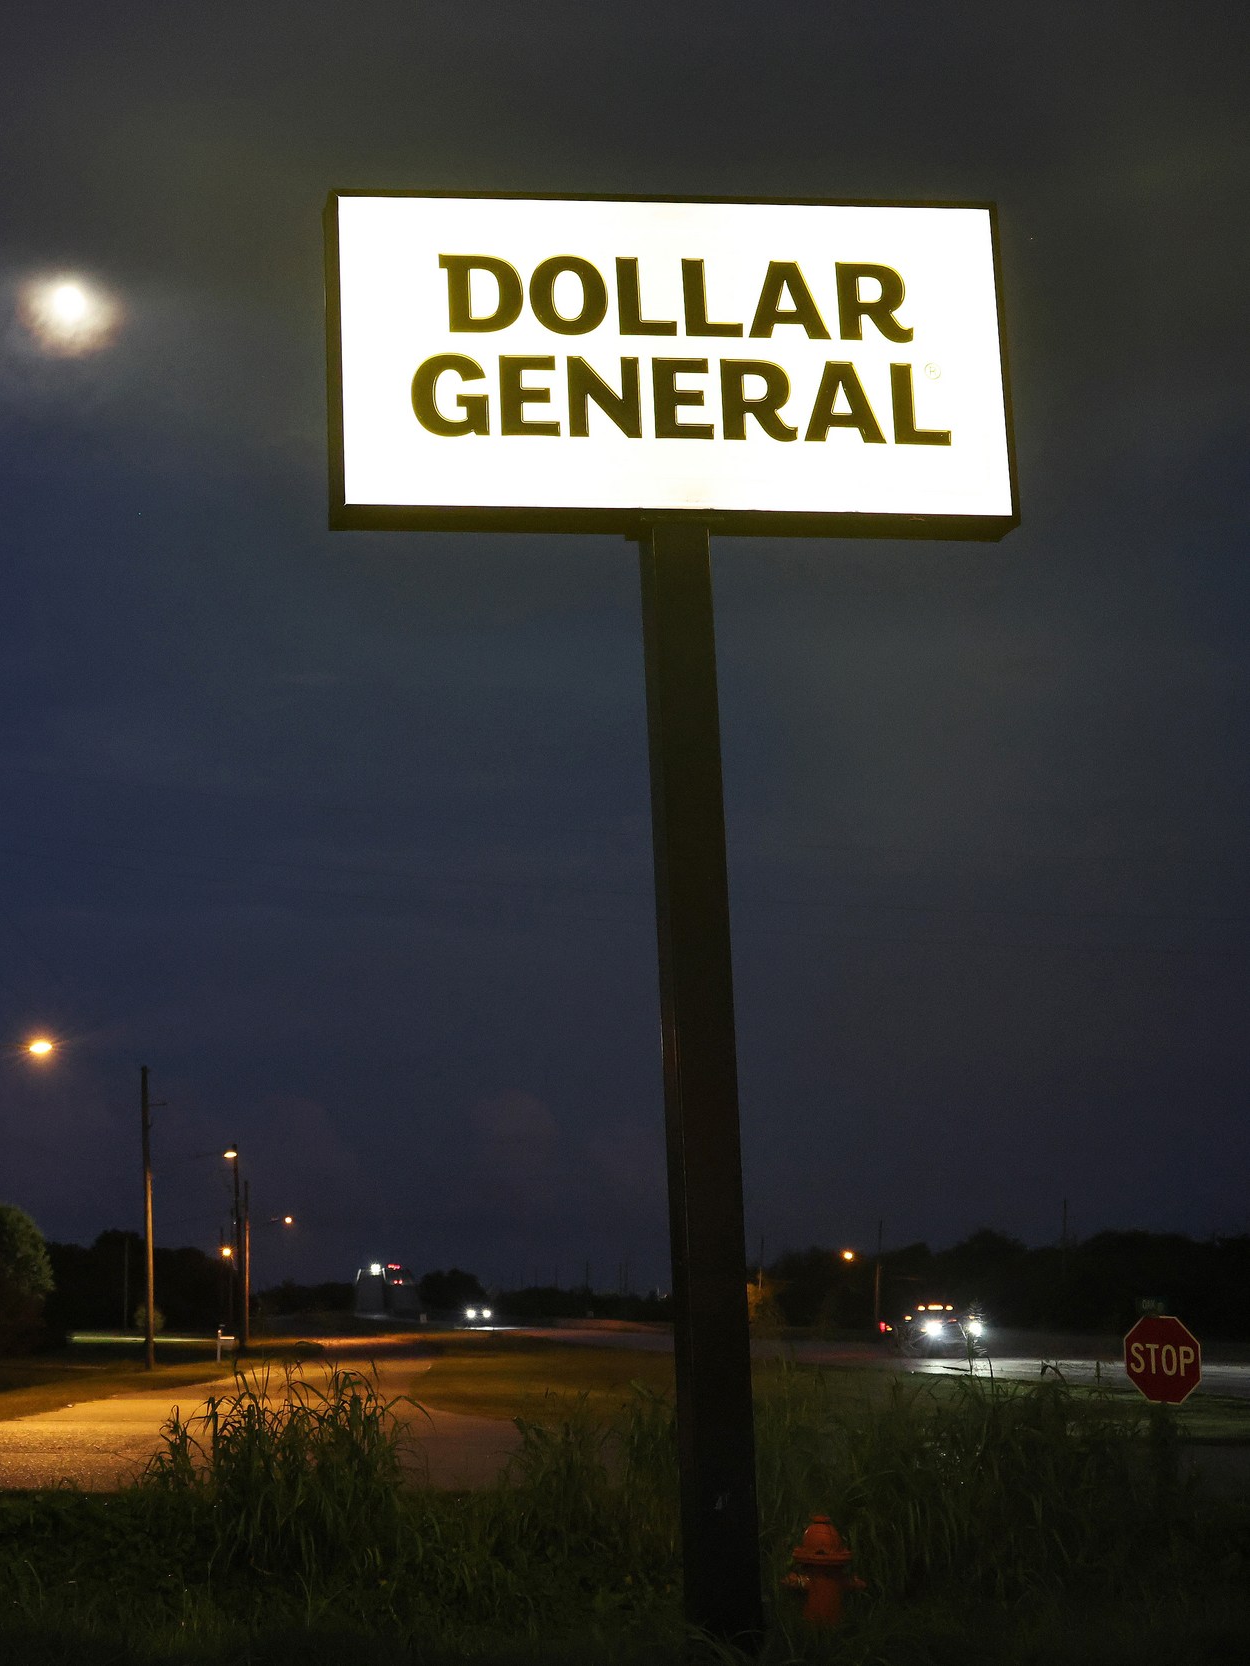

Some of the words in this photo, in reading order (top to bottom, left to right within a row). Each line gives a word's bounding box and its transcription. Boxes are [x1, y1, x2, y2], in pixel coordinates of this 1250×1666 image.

[438, 253, 914, 343] DOLLAR
[411, 353, 952, 446] GENERAL
[1130, 1342, 1195, 1377] STOP
